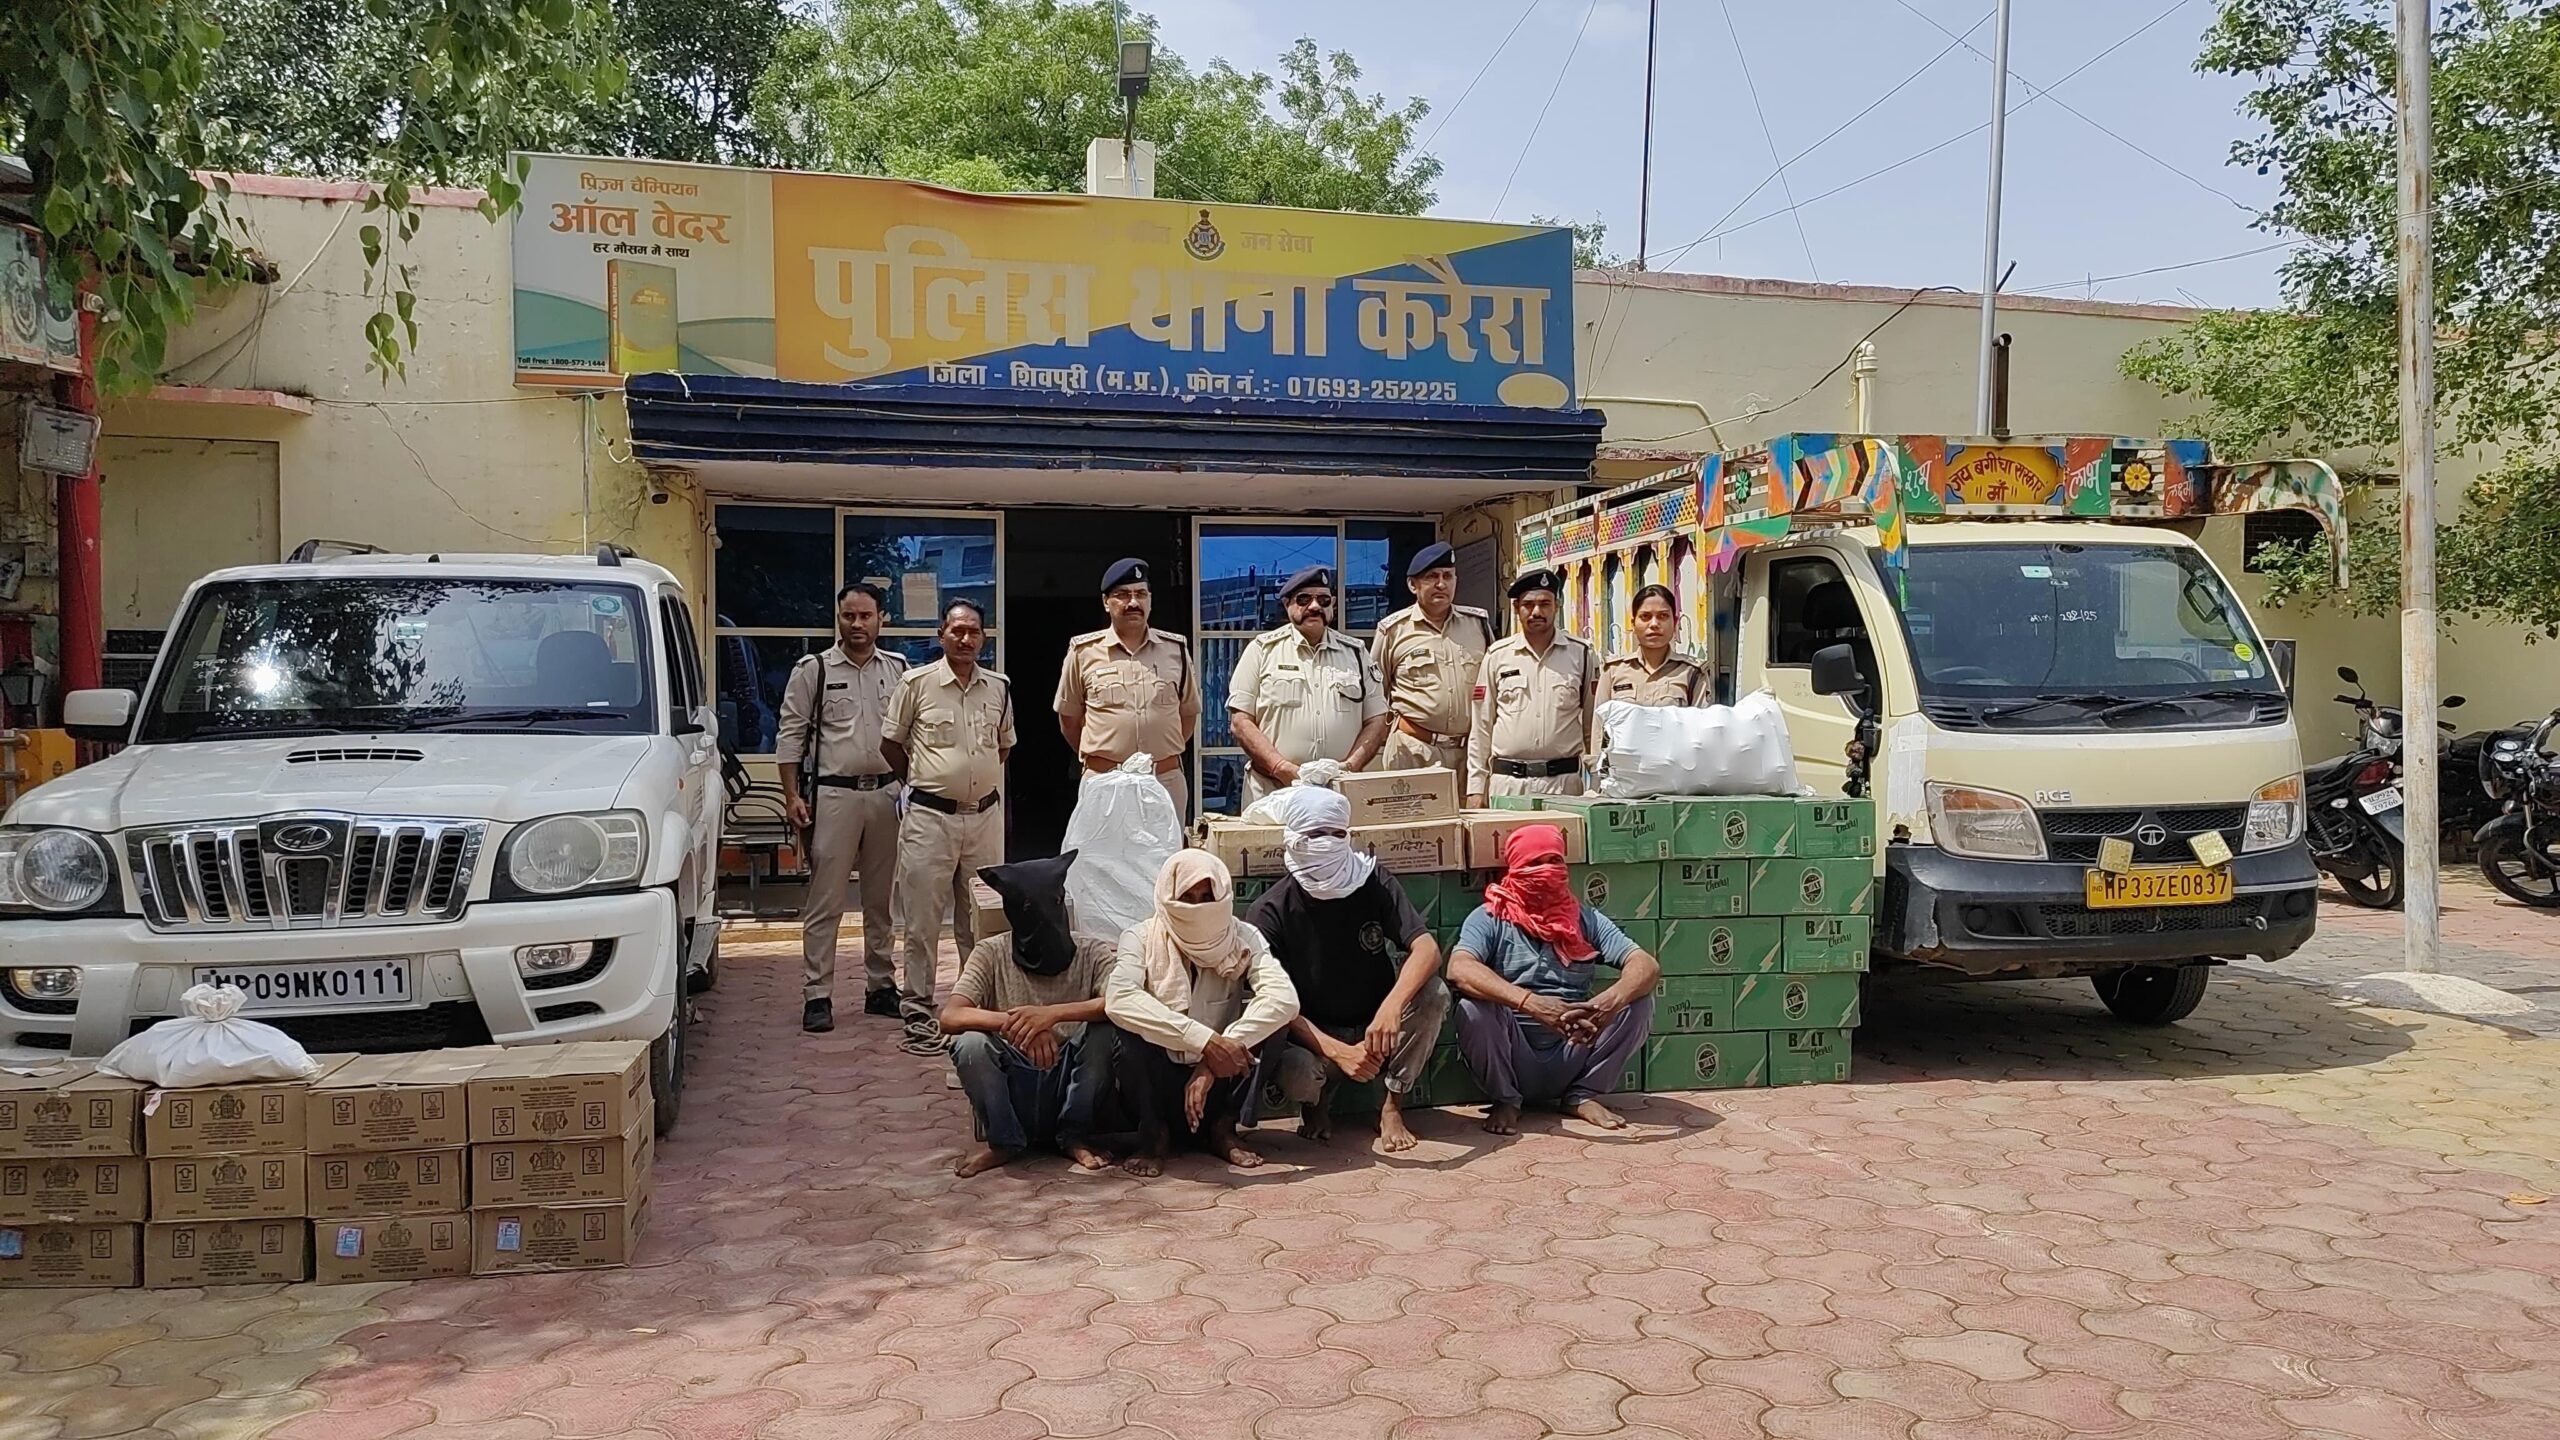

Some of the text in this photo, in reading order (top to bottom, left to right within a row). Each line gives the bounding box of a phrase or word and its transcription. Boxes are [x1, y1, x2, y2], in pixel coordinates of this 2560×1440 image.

[549, 197, 732, 244] ऑल वेदर
[593, 242, 610, 254] हर
[665, 247, 690, 258] साथ
[1240, 228, 1314, 253] जन सेवा
[807, 224, 1552, 373] पुलिस थाना करैरा
[928, 358, 988, 386] जिला
[1186, 368, 1231, 394] फोन
[1287, 376, 1457, 401] 07693-252225
[1904, 460, 1933, 498] शुभ
[1949, 464, 1974, 492] जय
[1973, 451, 2015, 476] बगीचा
[2066, 459, 2102, 499] लाभ
[2035, 789, 2071, 802] ACE
[2104, 872, 2229, 900] MP33ZE0837
